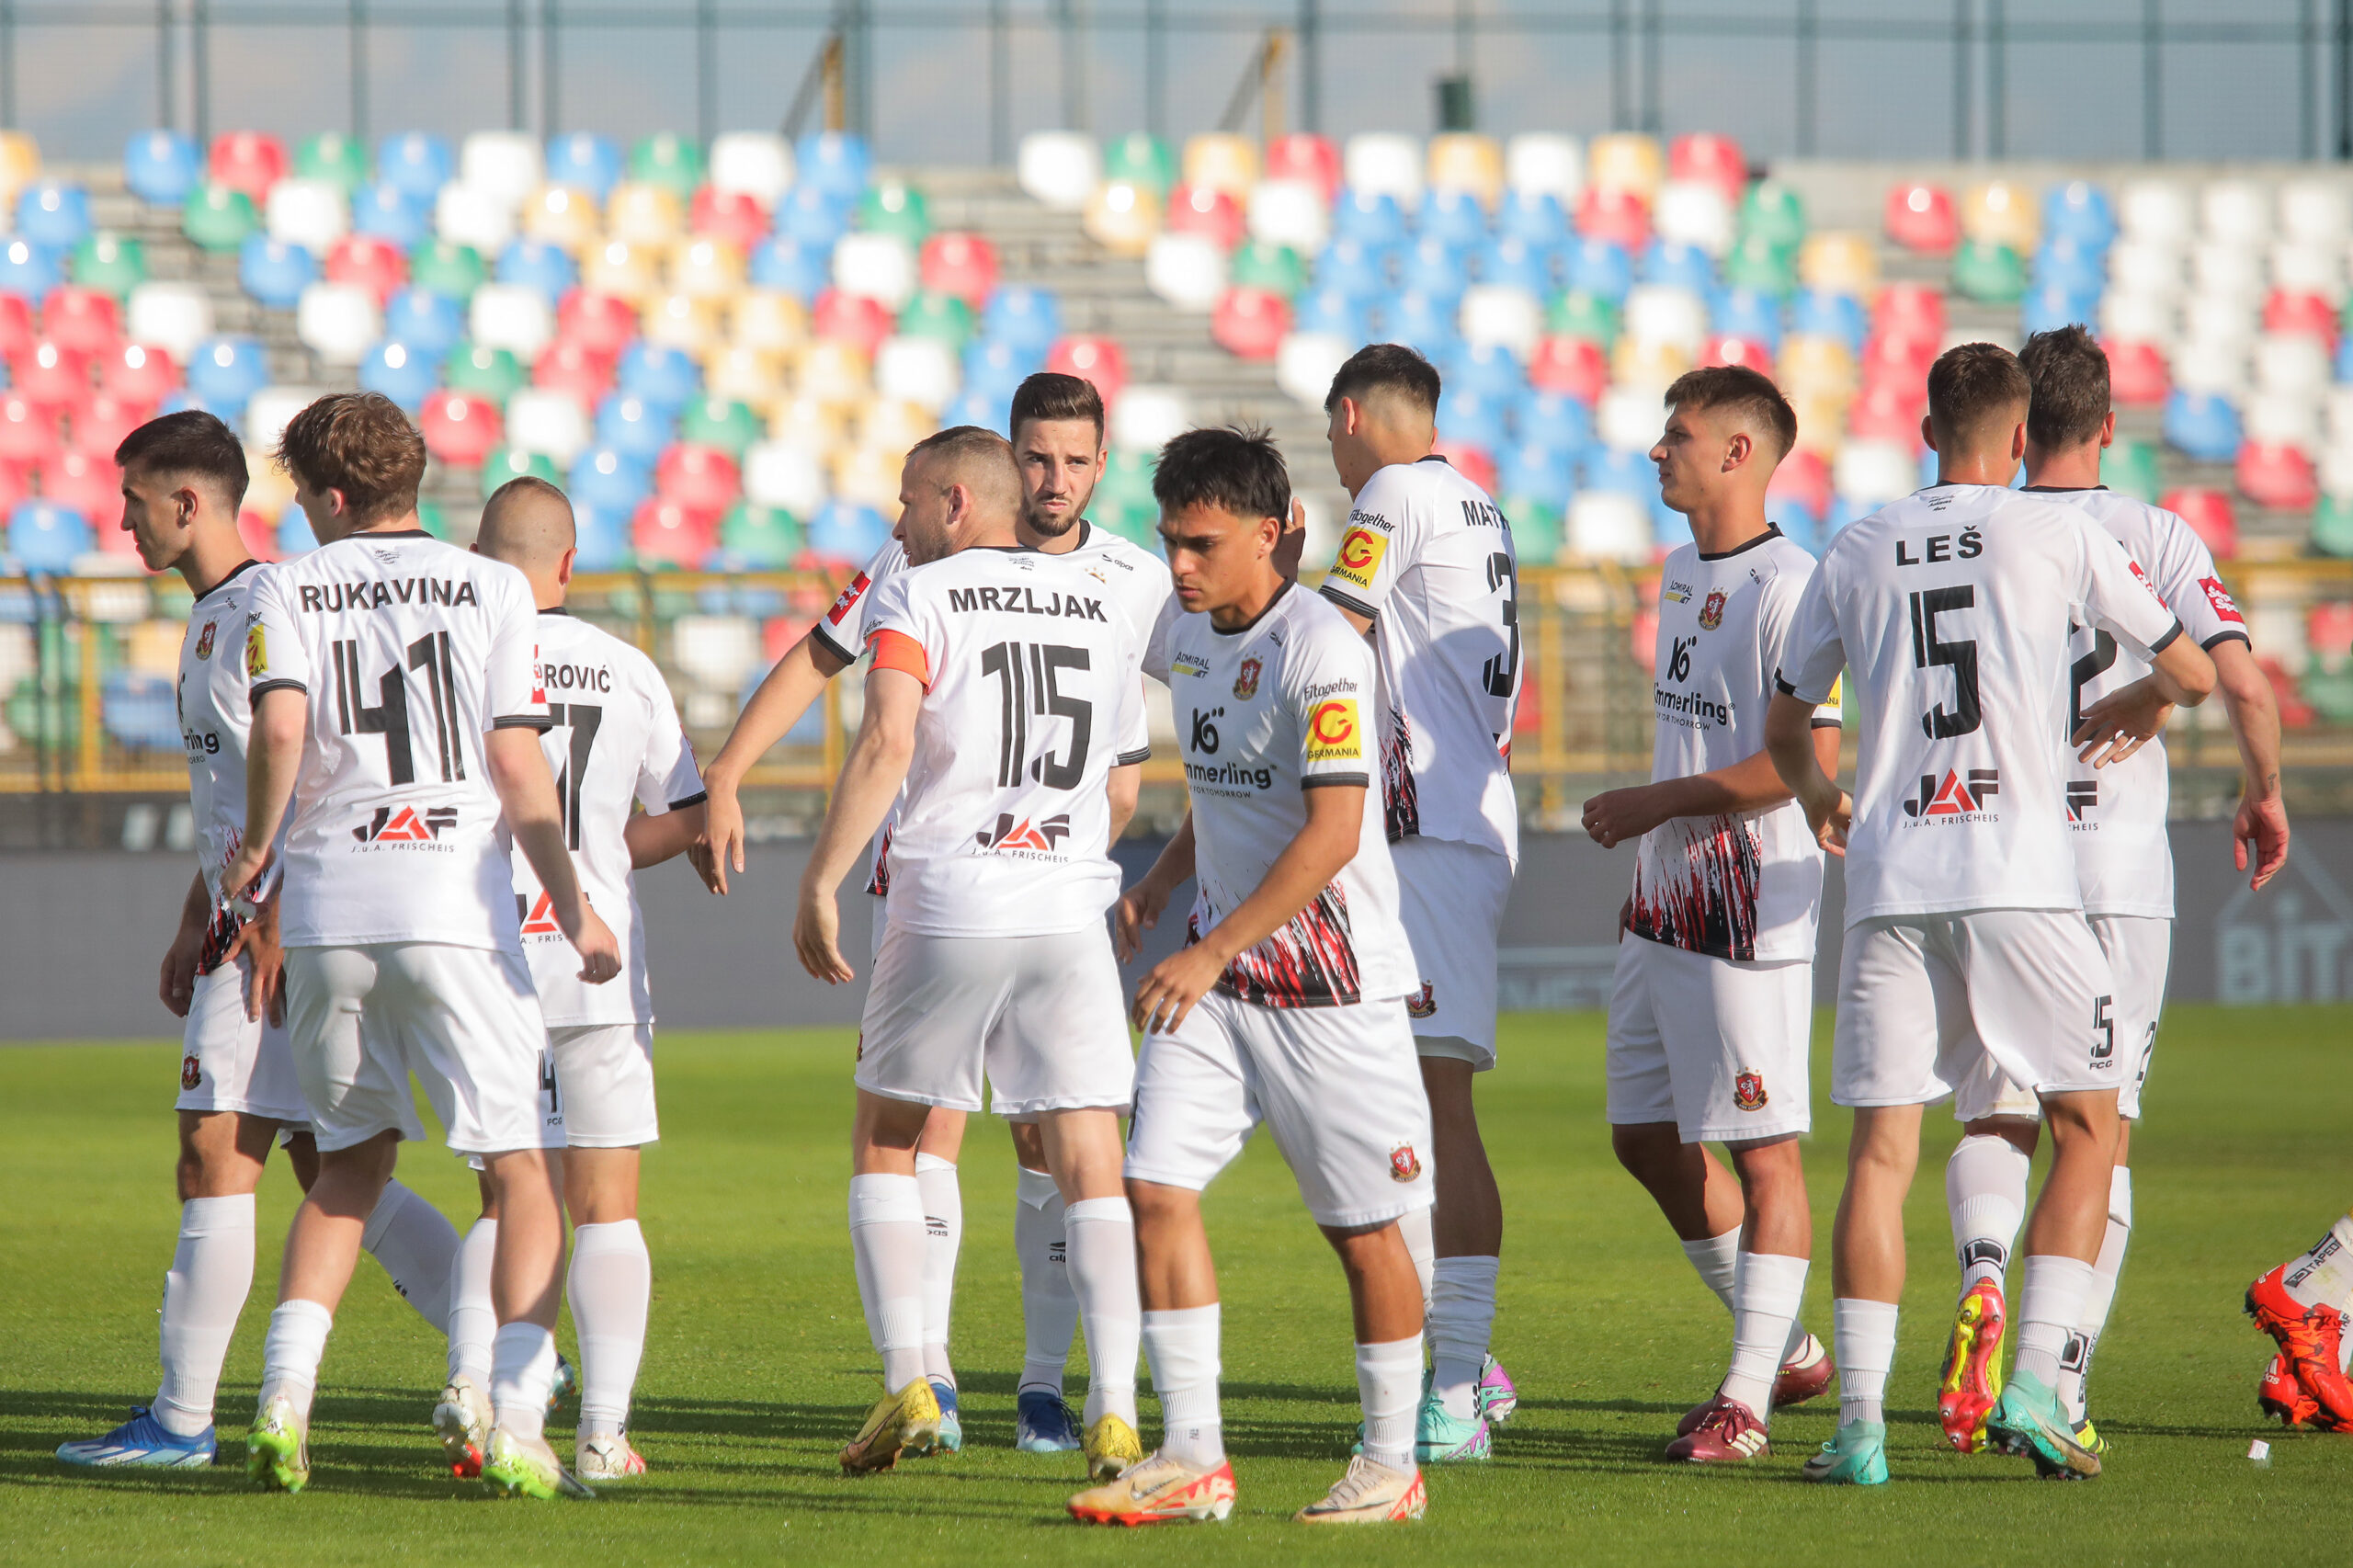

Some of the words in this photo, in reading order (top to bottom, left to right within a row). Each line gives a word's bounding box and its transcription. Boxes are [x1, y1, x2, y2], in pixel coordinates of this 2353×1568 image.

[1896, 524, 1984, 567] LEŠ
[298, 577, 478, 614] RUKAVINA
[948, 585, 1108, 624] MRZLJAK
[1482, 551, 1519, 699] 3
[1175, 651, 1210, 670] ADMIRAL
[1909, 584, 1983, 741] 5
[331, 630, 465, 786] 41
[981, 641, 1093, 791] 15
[1307, 748, 1359, 760] GERMANIA
[1941, 813, 2000, 826] FRISCHEIS
[392, 843, 456, 853] FRISCHEIS
[1012, 849, 1069, 863] FRISCHEIS
[2090, 994, 2114, 1058] 5
[2088, 1060, 2113, 1071] FCG
